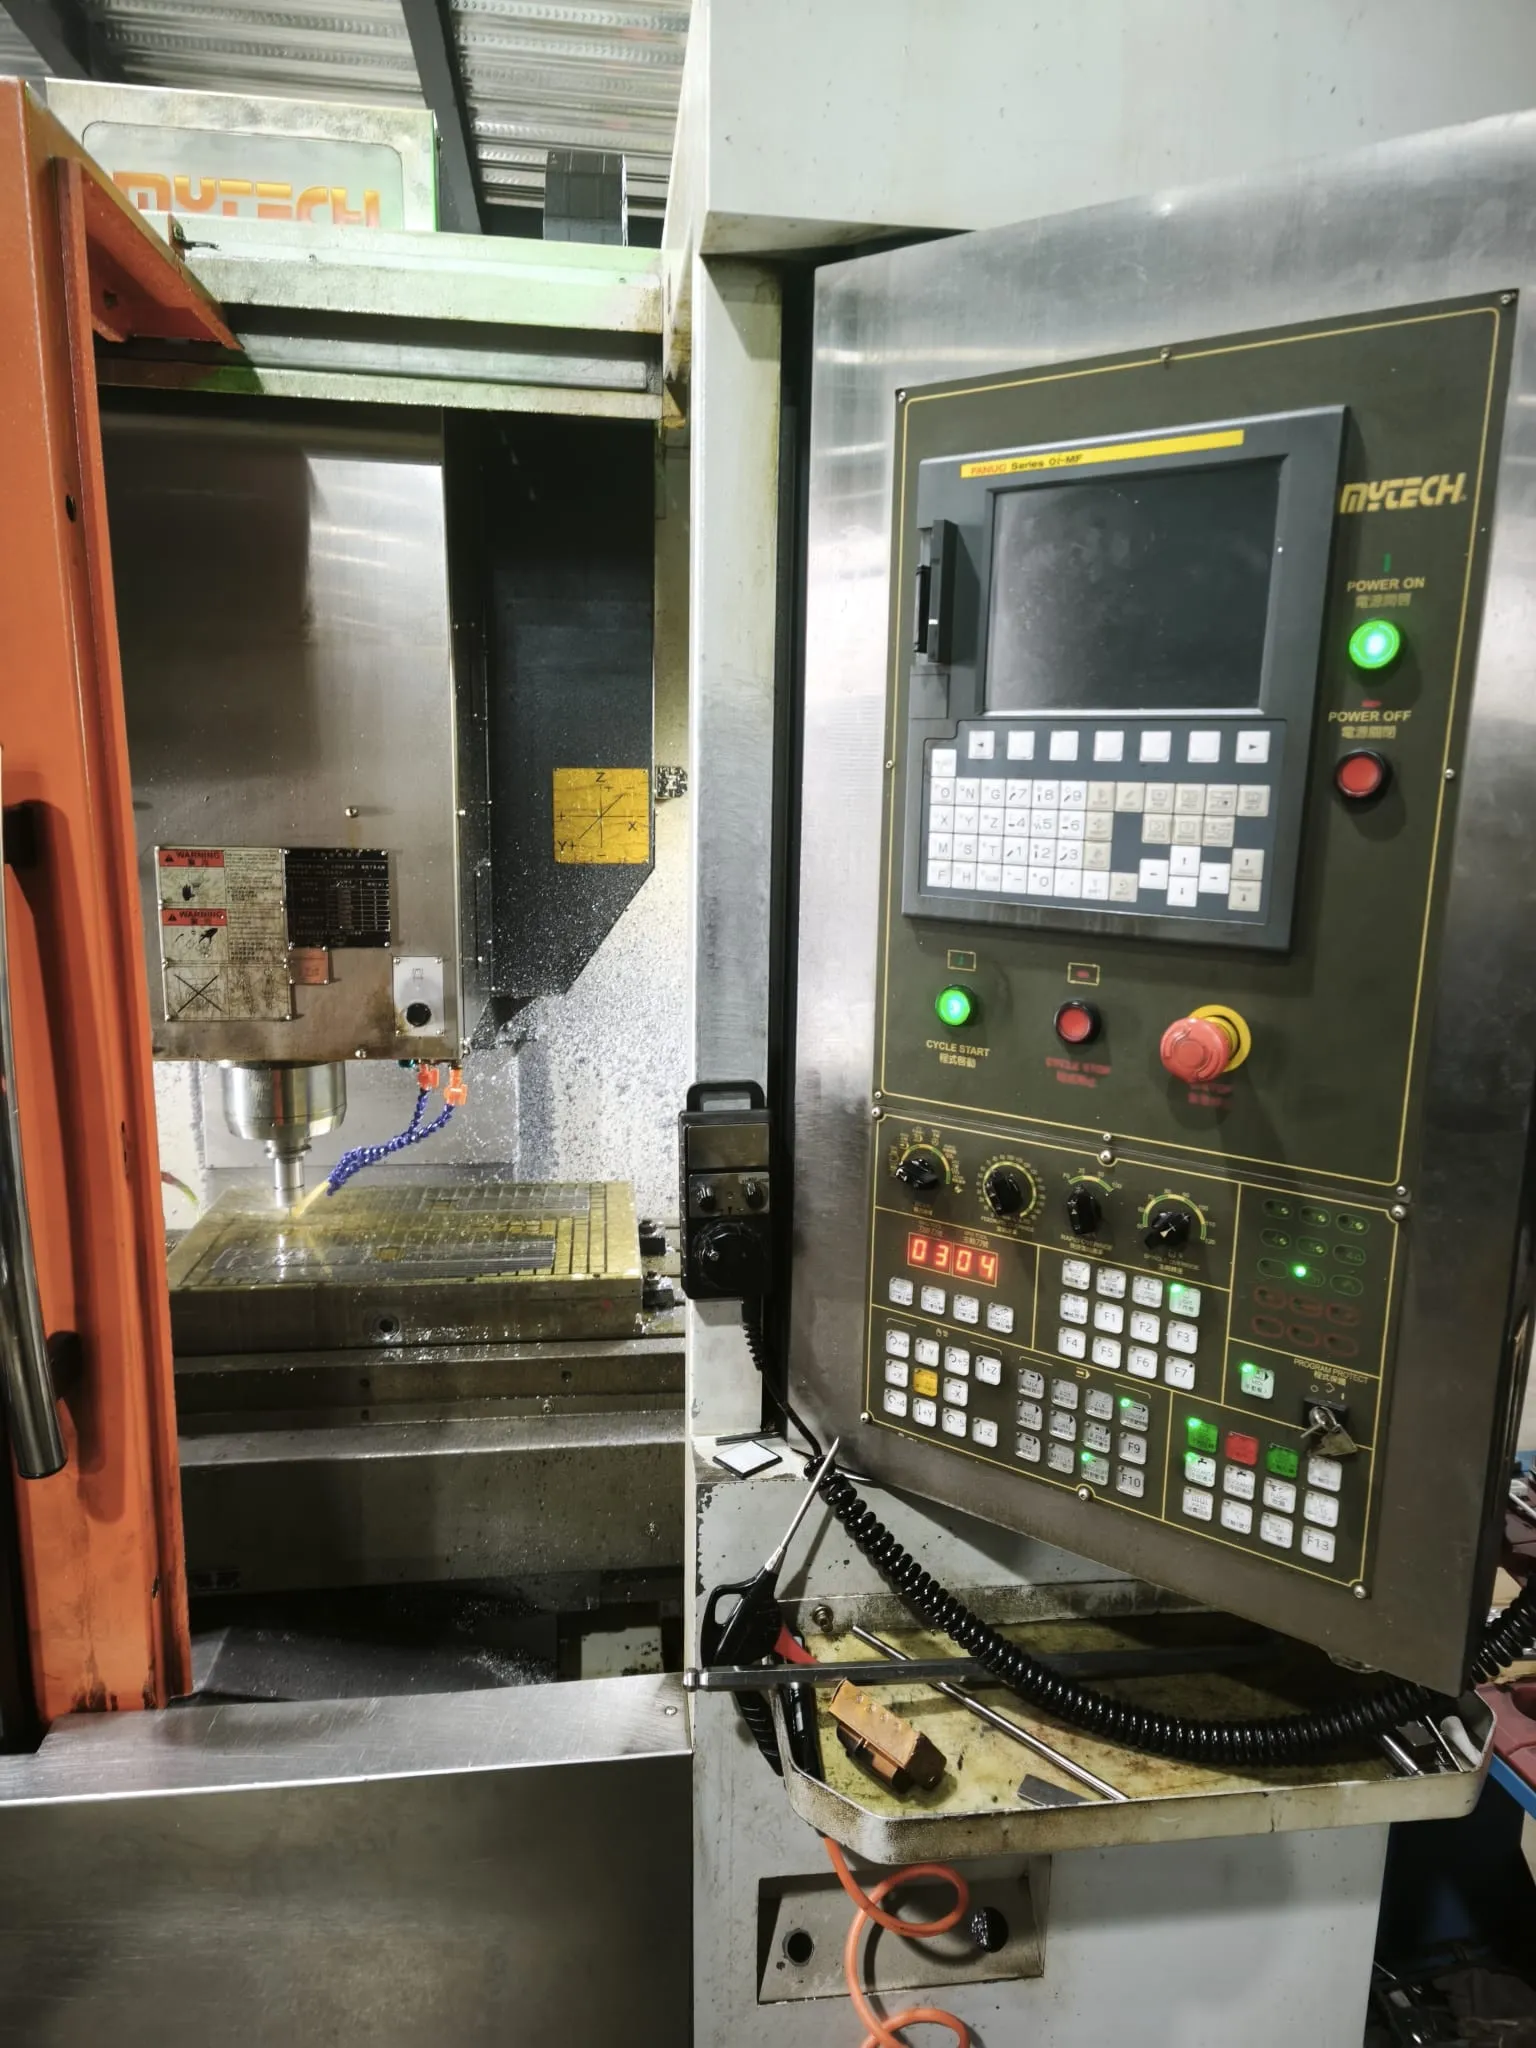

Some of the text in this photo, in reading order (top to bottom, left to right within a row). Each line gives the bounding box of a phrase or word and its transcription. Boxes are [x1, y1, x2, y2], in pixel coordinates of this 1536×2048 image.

[970, 463, 1007, 476] FANUC
[1010, 460, 1045, 472] Series
[1339, 472, 1466, 514] MYTECH
[1347, 576, 1426, 592] POWER ON
[1328, 710, 1412, 722] POWER OFF
[595, 771, 606, 783] Z
[966, 788, 975, 799] N
[991, 789, 1001, 801] G
[1019, 788, 1028, 799] 7
[1045, 789, 1054, 801] 8
[1073, 790, 1082, 801] 9
[940, 815, 949, 826] X
[965, 815, 974, 825] Y
[990, 817, 999, 829] Z
[1015, 818, 1025, 829] 4
[1043, 820, 1052, 830] 5
[1071, 820, 1080, 831] 6
[628, 821, 638, 832] X
[938, 842, 949, 853] M
[963, 844, 973, 855] S
[990, 845, 999, 857] T
[176, 851, 221, 860] WARNING
[1041, 848, 1050, 859] 2
[1069, 849, 1079, 861] 3
[937, 870, 946, 880] F
[962, 871, 972, 883] H
[179, 911, 224, 921] WARNING
[926, 1039, 990, 1057] CYCLE START
[1104, 1312, 1116, 1323] F1
[1139, 1321, 1152, 1333] F2
[1066, 1337, 1078, 1348] F4
[1176, 1331, 1190, 1343] F3
[1100, 1346, 1113, 1357] F5
[1136, 1356, 1149, 1368] F6
[1174, 1367, 1187, 1378] F7
[1294, 1357, 1368, 1385] PROGRAM PROTECT
[1127, 1441, 1140, 1454] F9
[1121, 1474, 1141, 1488] F10
[1307, 1535, 1329, 1551] F13
